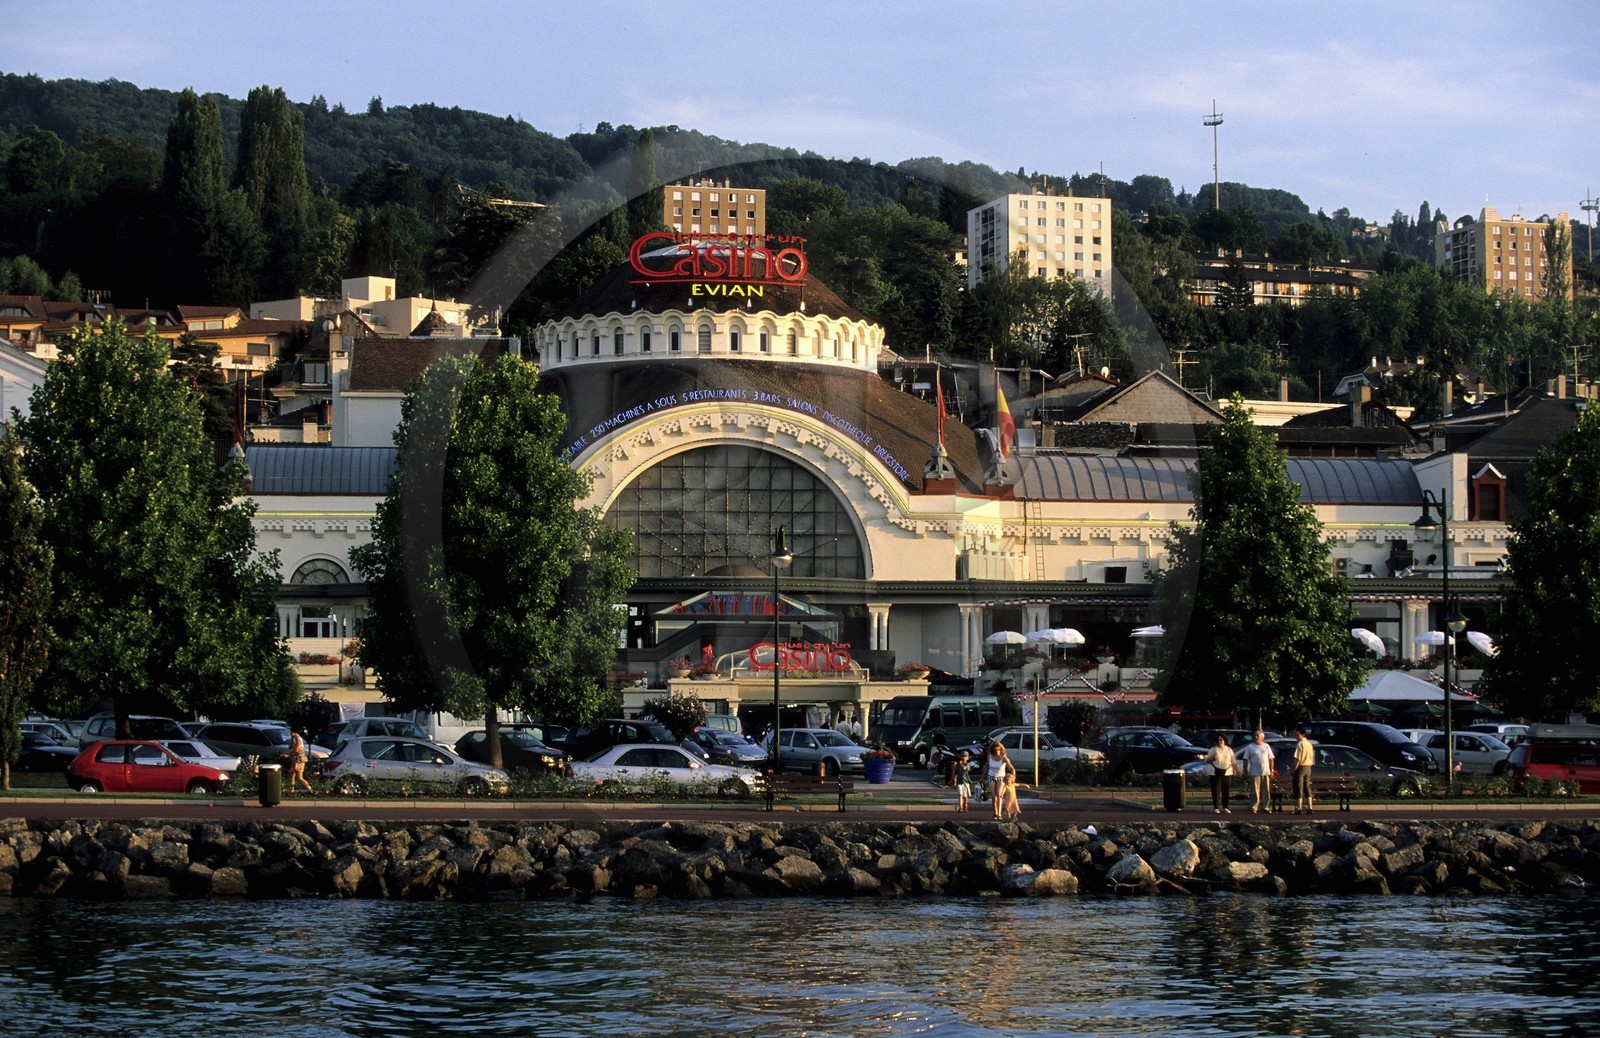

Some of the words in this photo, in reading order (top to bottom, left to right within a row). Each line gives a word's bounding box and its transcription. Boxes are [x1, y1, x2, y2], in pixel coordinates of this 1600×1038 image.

[629, 231, 808, 281] Casino
[692, 283, 763, 297] EVIAN
[590, 424, 605, 438] 250
[605, 404, 645, 429] MACHINES
[647, 402, 654, 411] A
[654, 394, 677, 408] SOUS
[689, 389, 746, 401] RESTAURANTS
[753, 391, 759, 401] 3
[760, 392, 781, 404] BARS
[786, 398, 818, 415] SALONS
[822, 411, 873, 446] DISCOTHEQUE
[873, 444, 910, 482] DRUGSTORE
[748, 642, 852, 670] Casino
